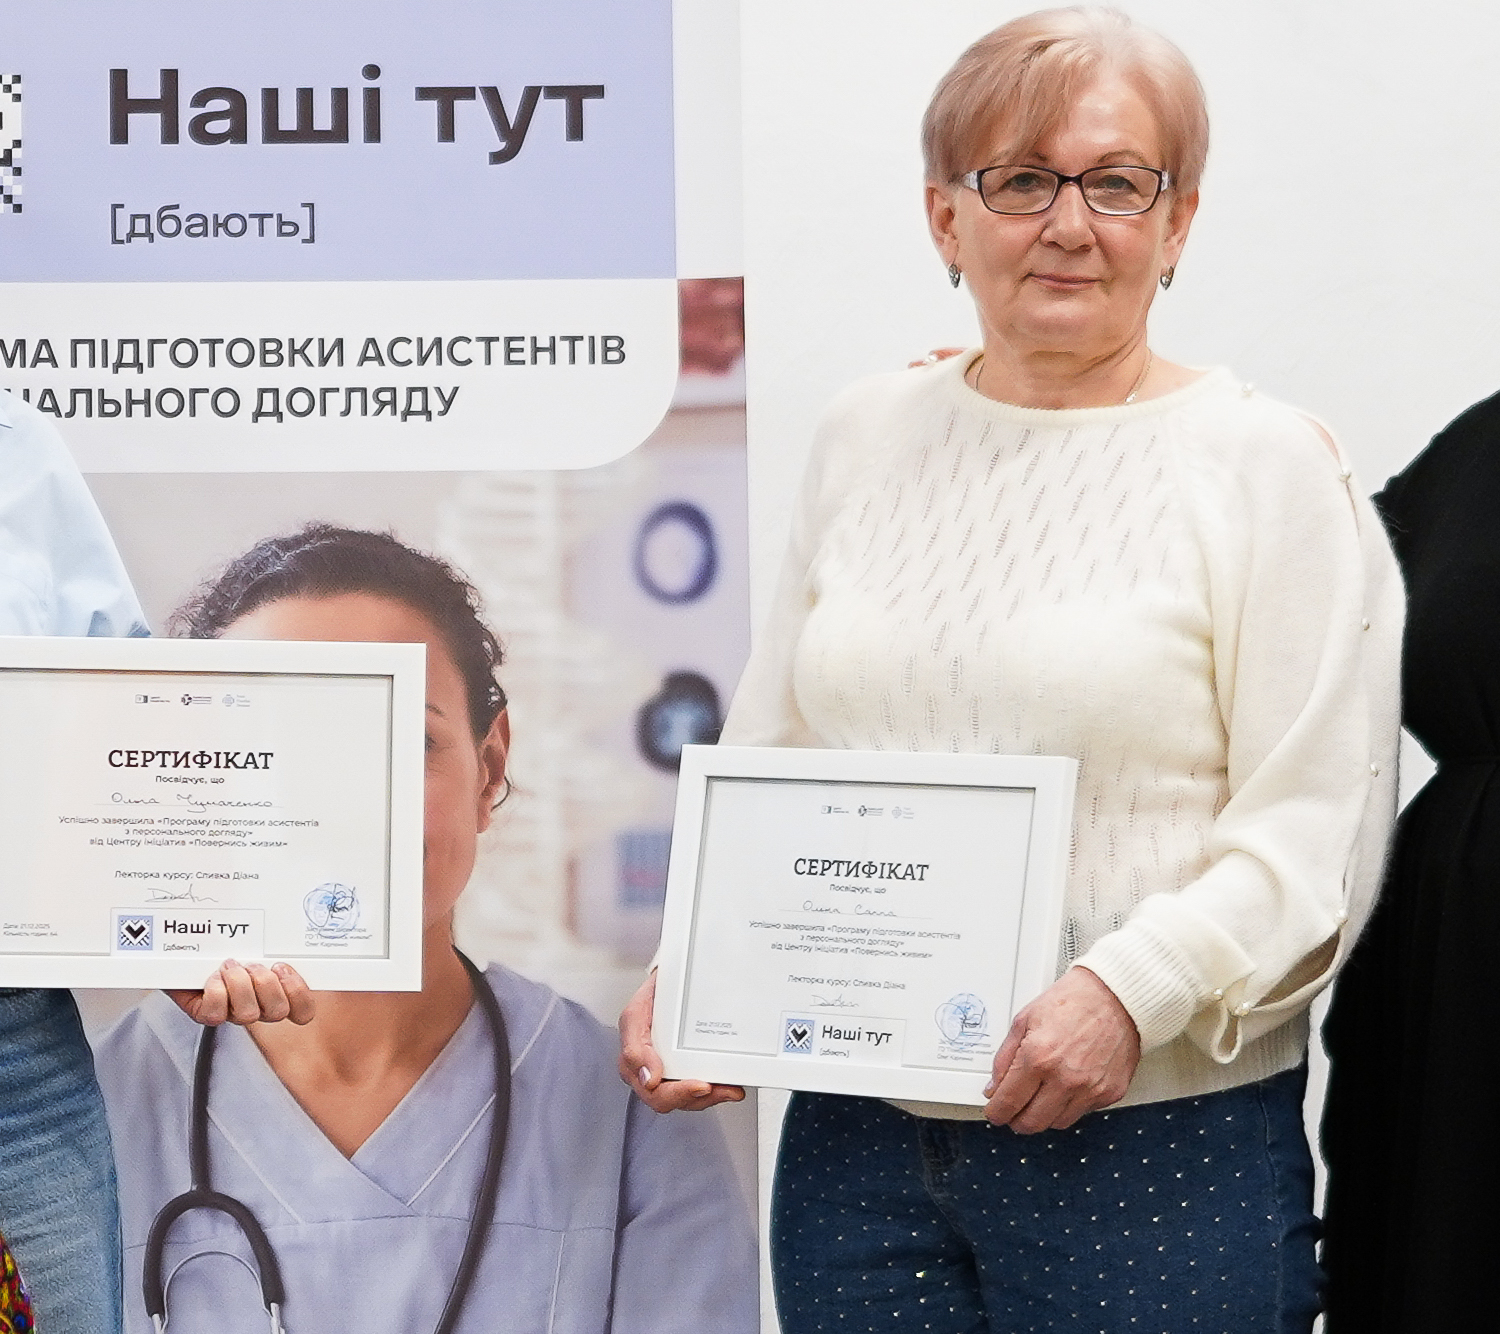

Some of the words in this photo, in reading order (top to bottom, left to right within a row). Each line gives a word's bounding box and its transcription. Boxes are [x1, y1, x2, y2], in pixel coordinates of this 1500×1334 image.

[108, 64, 382, 146] Наші
[415, 83, 606, 166] тут
[110, 201, 318, 246] [дбають]
[70, 336, 346, 375] ПІДГОТОВКИ
[357, 333, 627, 369] АСИСТЕНТІВ
[251, 384, 460, 424] ДОГЛЯДУ
[107, 748, 274, 771] СЕРТИФІКАТ
[793, 857, 930, 881] СЕРТИФІКАТ
[163, 919, 212, 935] Наші
[217, 923, 249, 938] тут
[821, 1024, 862, 1044] Наші
[865, 1029, 894, 1047] тут
